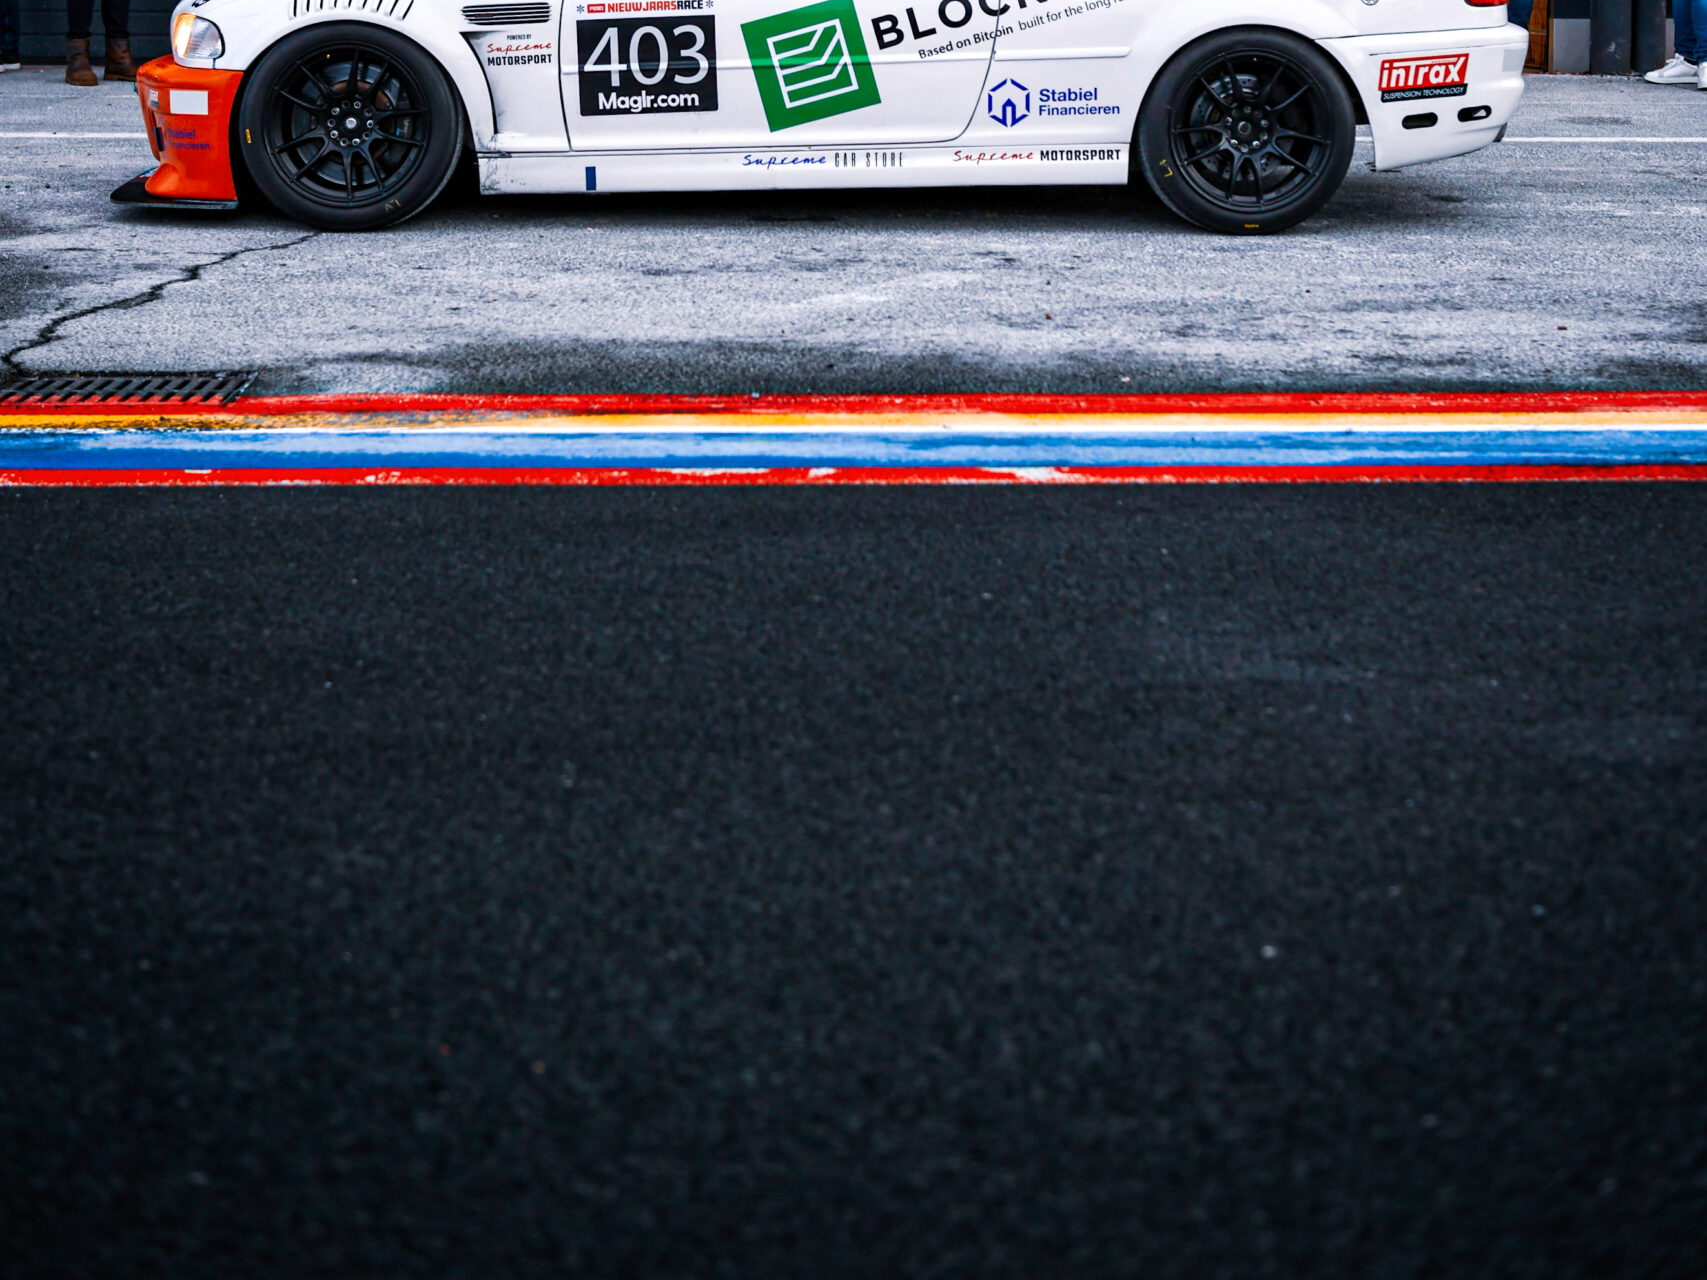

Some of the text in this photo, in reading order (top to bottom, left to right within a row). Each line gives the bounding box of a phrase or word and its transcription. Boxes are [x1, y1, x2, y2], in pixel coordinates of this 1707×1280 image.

[918, 39, 954, 60] Based
[956, 37, 972, 50] on
[973, 24, 1015, 45] Bitcoin
[1018, 15, 1046, 32] built
[1046, 11, 1063, 25] for
[1064, 4, 1084, 18] the
[486, 42, 552, 56] Supreme
[583, 24, 710, 88] 403
[487, 54, 553, 67] MOTORSPORT
[598, 89, 700, 113] Maglr.com
[1038, 87, 1098, 102] Stabiel
[1383, 86, 1465, 100] SUSPENSION TECHNOLOGY
[1038, 104, 1121, 116] Financieren
[742, 151, 904, 170] Supreme CAR STORE
[952, 148, 1122, 165] Supreme MOTORSPORT
